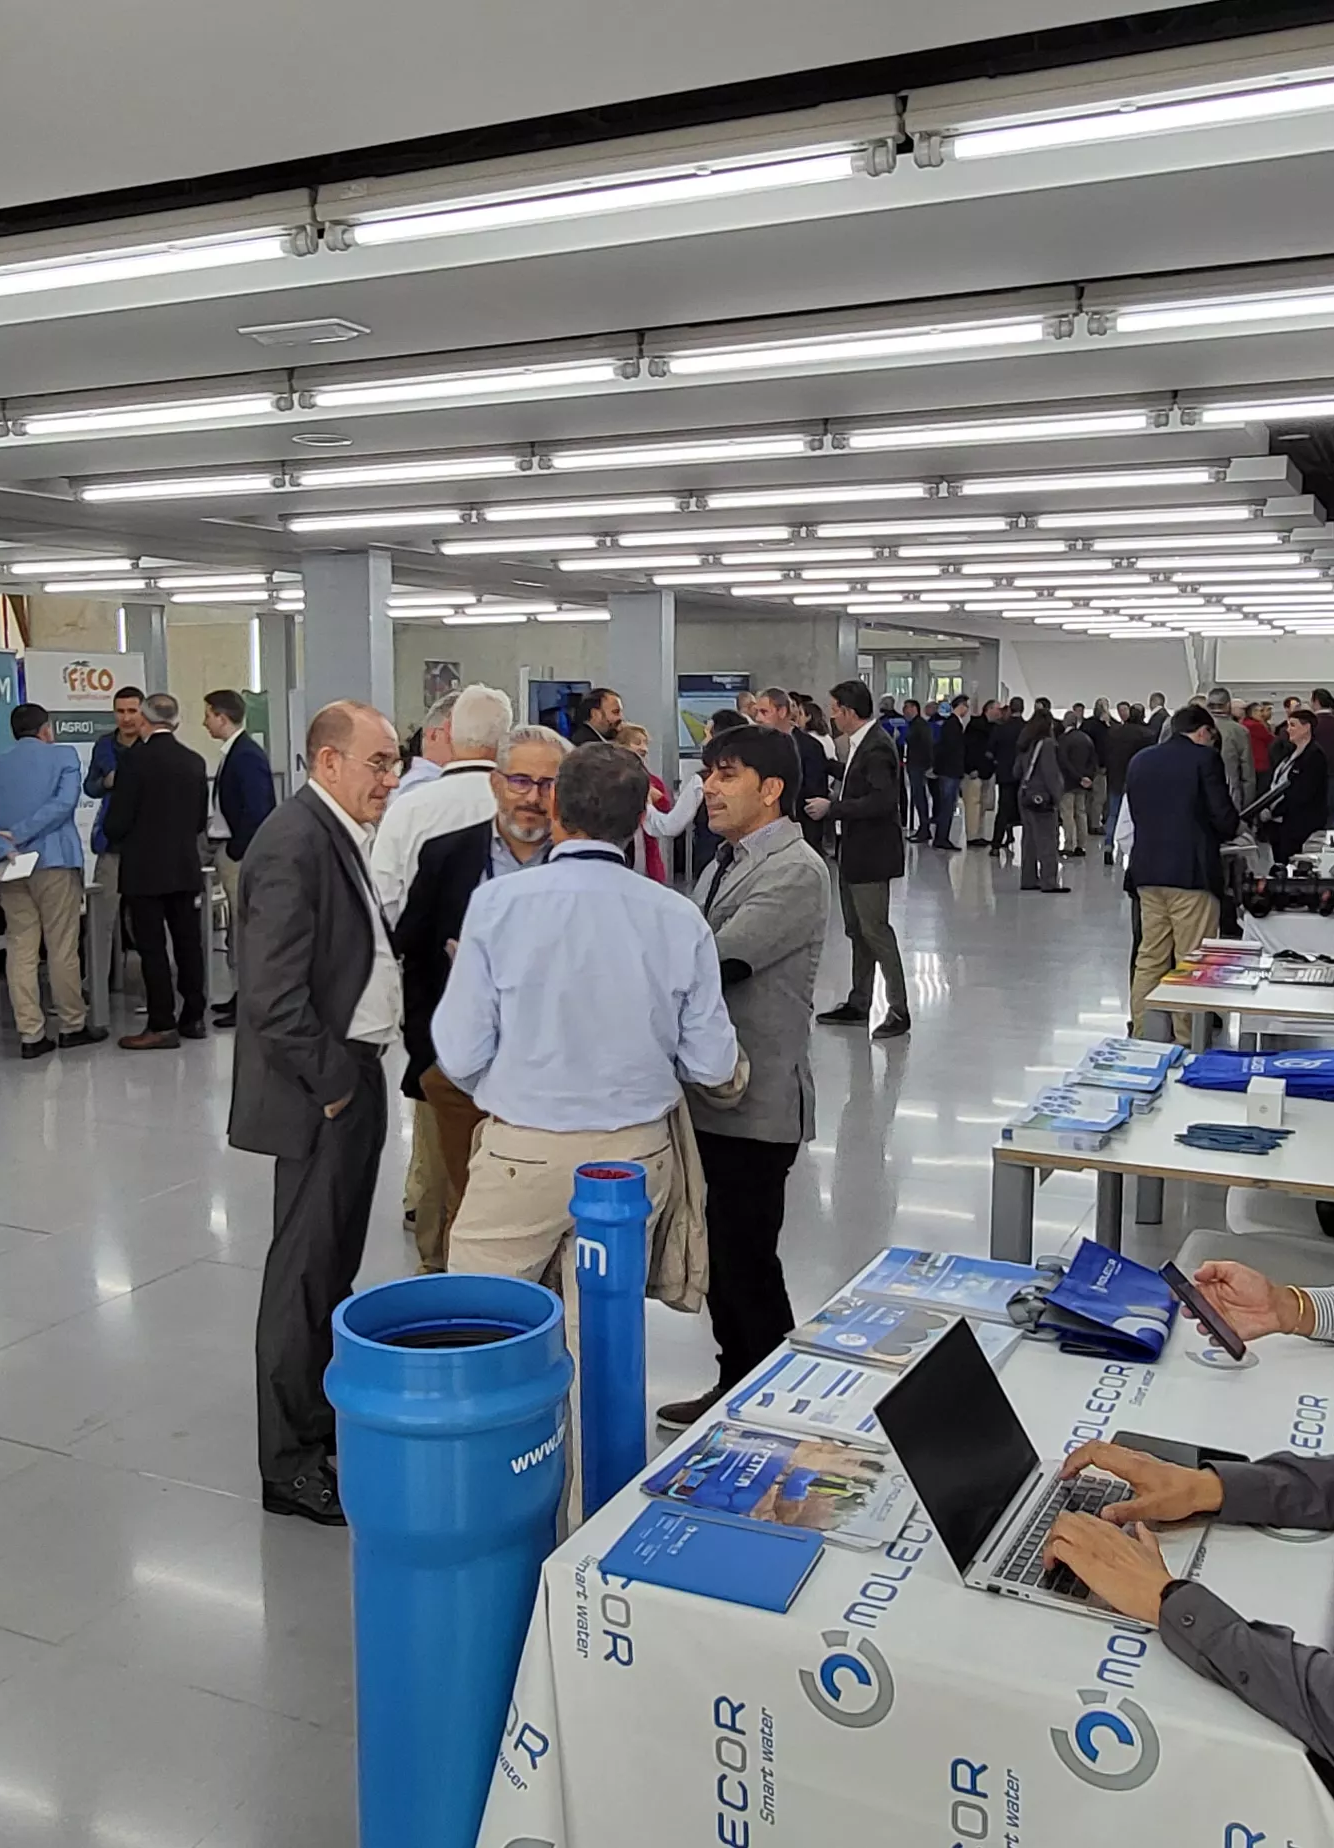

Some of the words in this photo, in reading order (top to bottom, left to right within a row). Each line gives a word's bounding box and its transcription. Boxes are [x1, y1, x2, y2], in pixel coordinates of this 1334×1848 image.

[1289, 1394, 1329, 1456] ECOR
[575, 1604, 590, 1659] water
[760, 1706, 775, 1764] water
[760, 1765, 776, 1825] Smart
[1004, 1768, 1020, 1827] water
